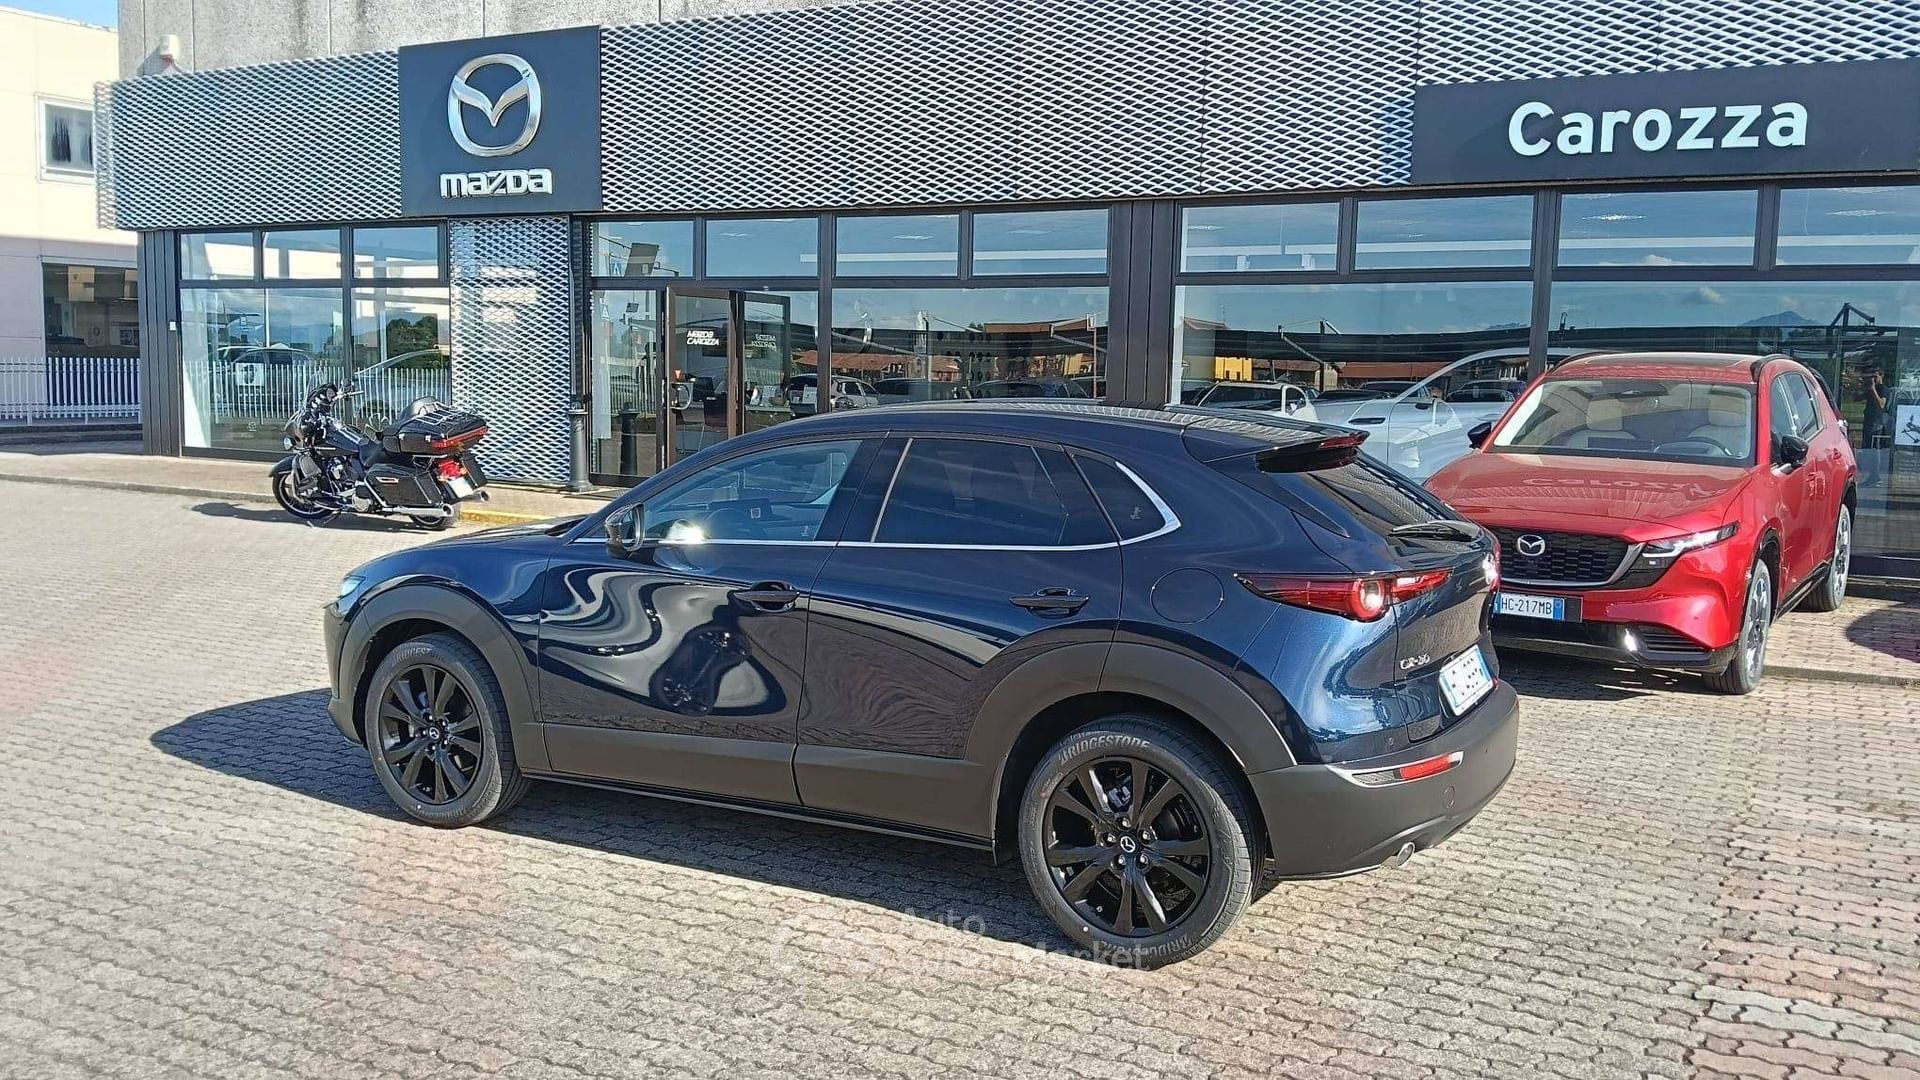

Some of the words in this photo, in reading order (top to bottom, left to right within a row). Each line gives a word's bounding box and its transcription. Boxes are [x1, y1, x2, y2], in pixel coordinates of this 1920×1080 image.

[1508, 101, 1808, 156] Carozza
[1500, 597, 1552, 615] HC-217MB
[1059, 735, 1151, 765] BRIDGESTONE
